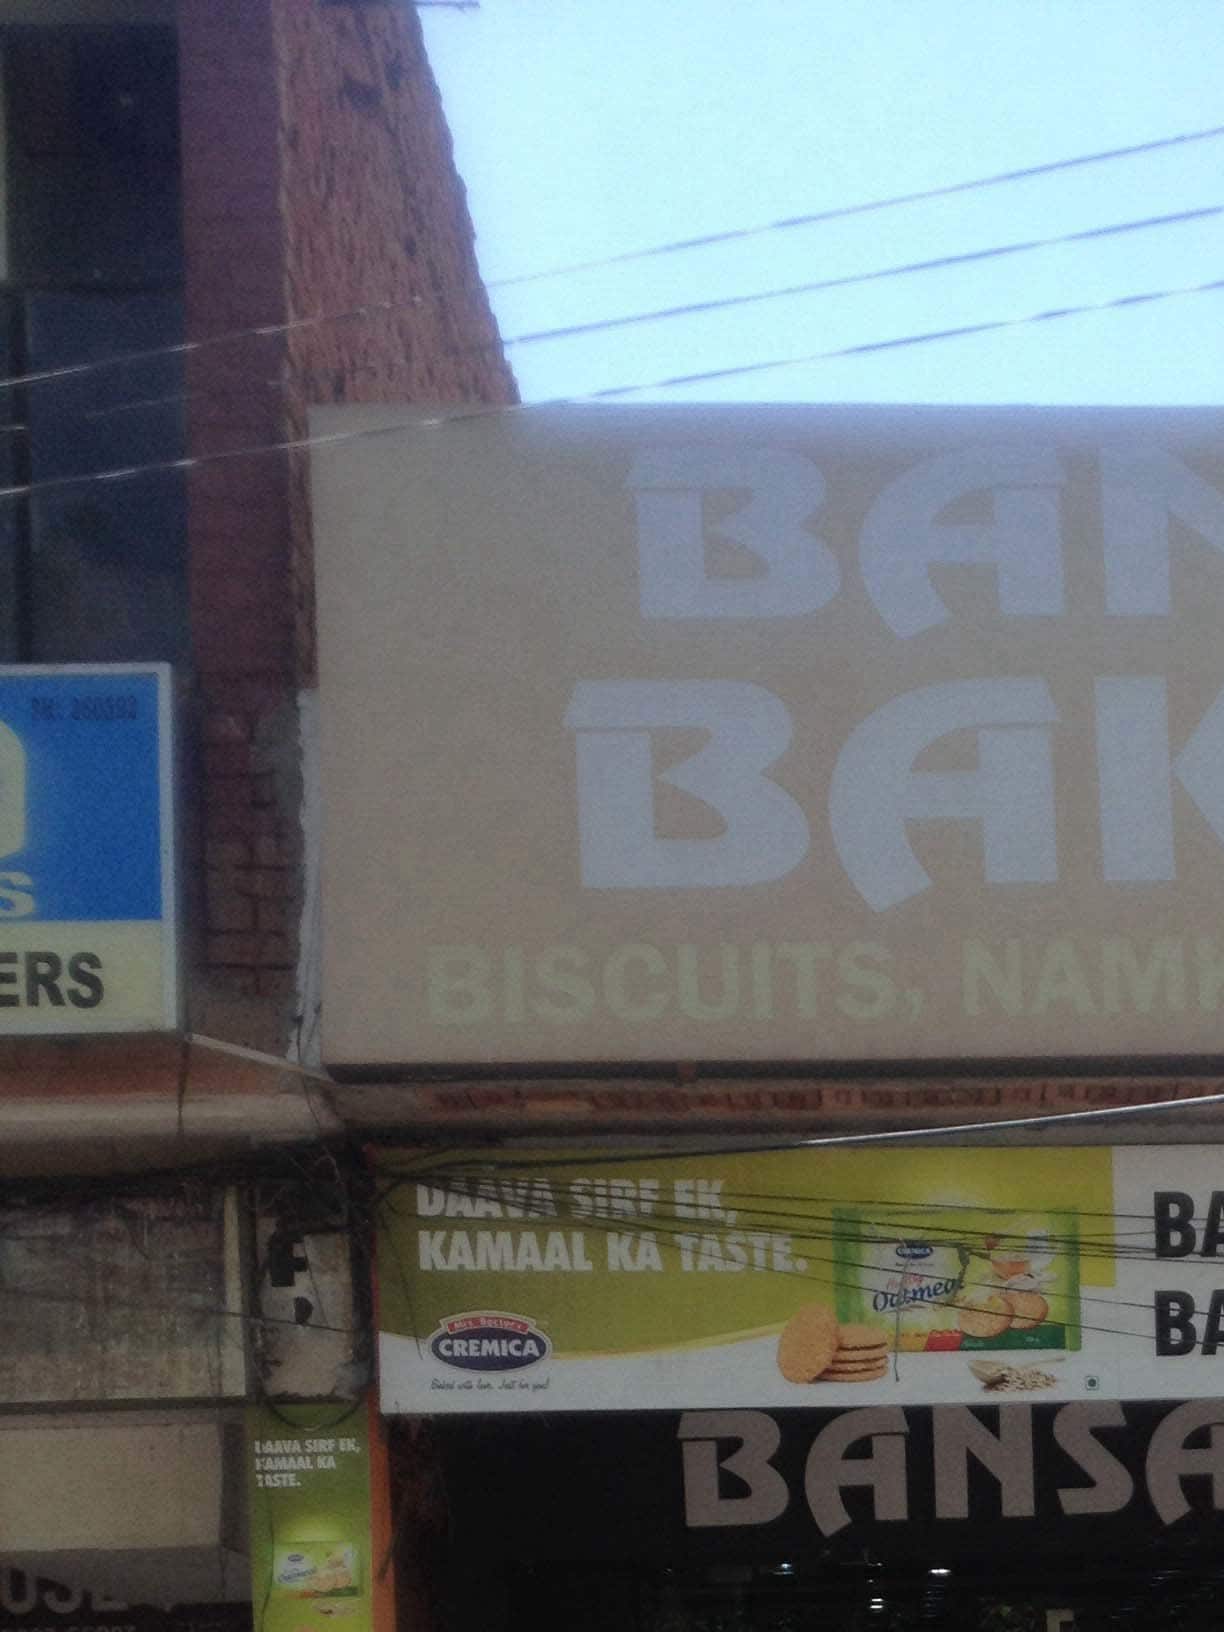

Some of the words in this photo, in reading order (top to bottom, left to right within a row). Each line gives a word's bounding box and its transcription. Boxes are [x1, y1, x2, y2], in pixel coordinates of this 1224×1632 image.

[416, 1178, 558, 1217] DAAVA
[568, 1178, 660, 1216] SIRF
[417, 1231, 593, 1272] KAMAAL
[606, 1231, 664, 1272] KA
[675, 1232, 808, 1272] TASTE.
[438, 1338, 540, 1358] CREMICA
[317, 1455, 336, 1469] KA
